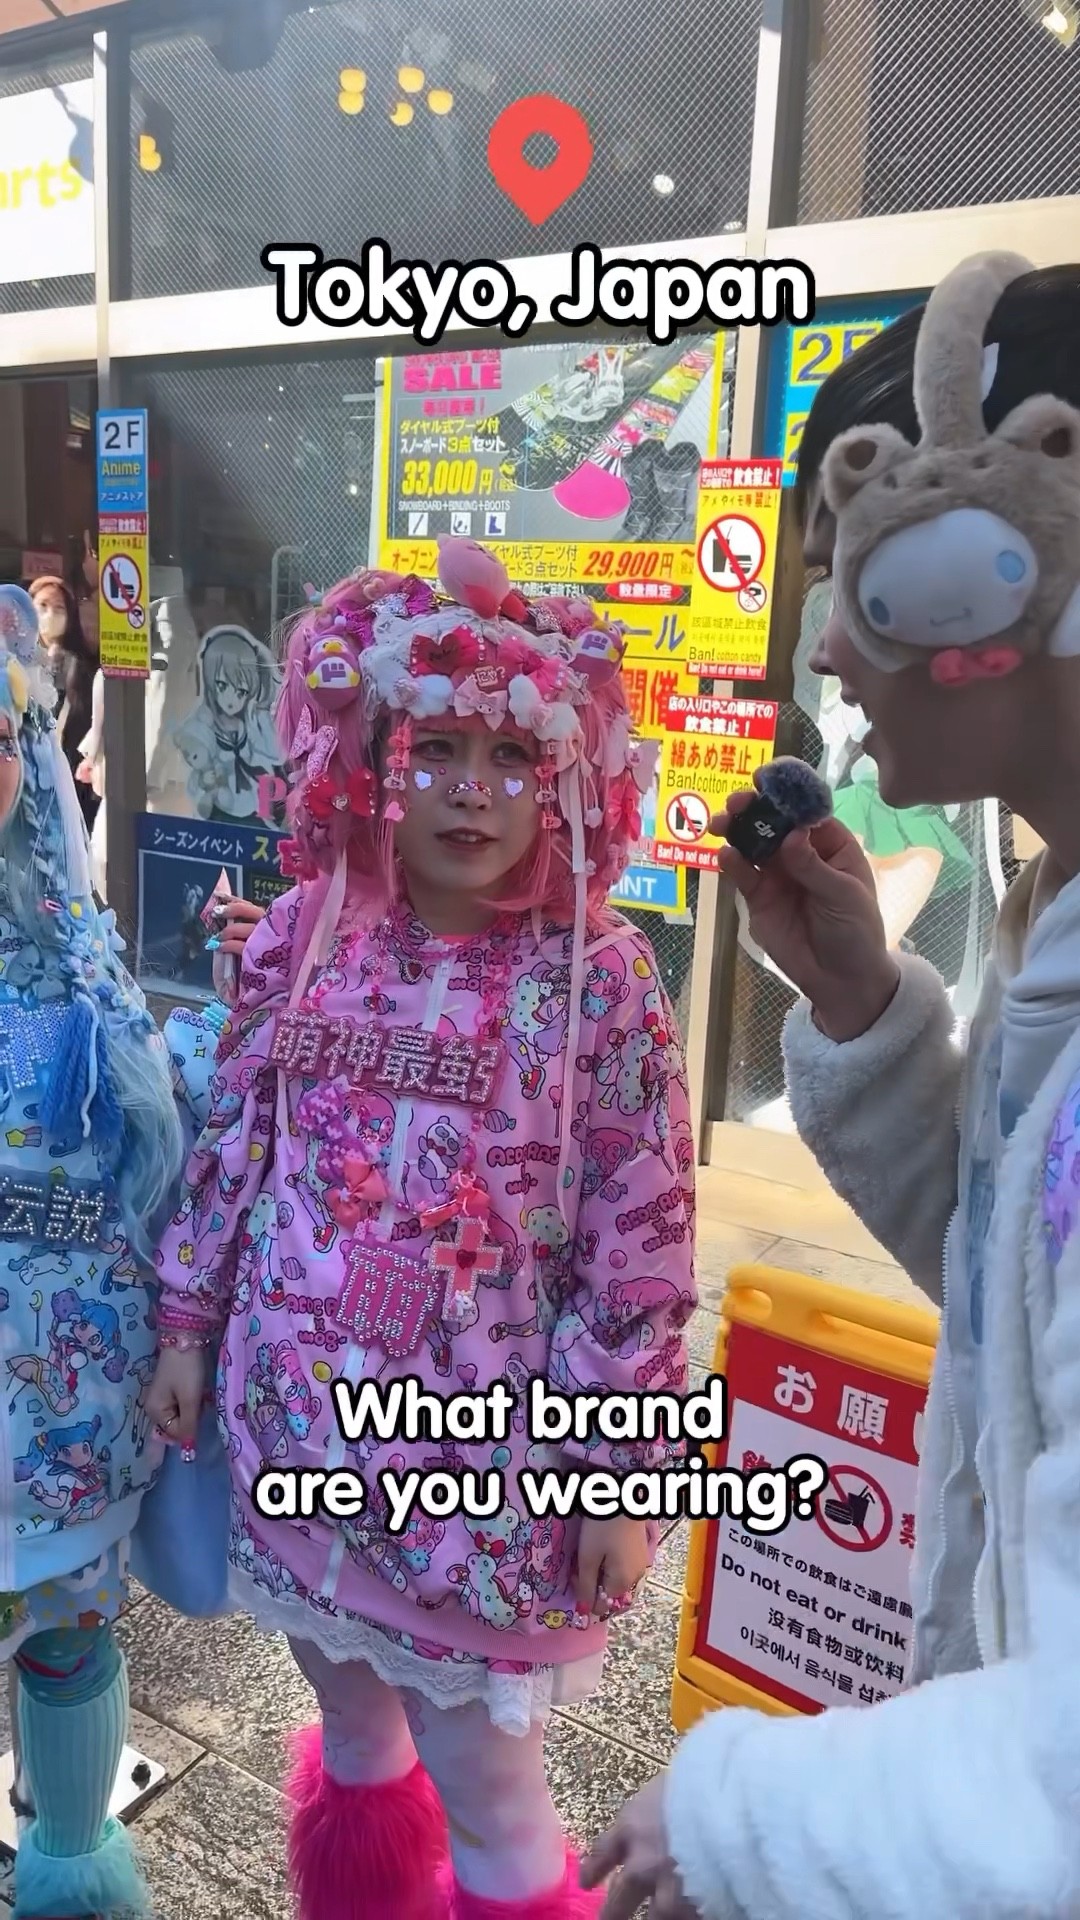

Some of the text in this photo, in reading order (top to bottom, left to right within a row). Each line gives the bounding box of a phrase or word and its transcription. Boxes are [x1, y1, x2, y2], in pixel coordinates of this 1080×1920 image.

[404, 364, 502, 393] SALE
[104, 420, 140, 449] 2F
[101, 461, 141, 476] Anime
[688, 646, 715, 661] Ban!
[153, 828, 244, 859] シーズンイベント
[721, 1553, 908, 1652] Do not eat or drink
[740, 1625, 801, 1670] 이곳에서
[803, 1657, 855, 1696] 음식물
[767, 1606, 905, 1685] 没有食物或饮料
